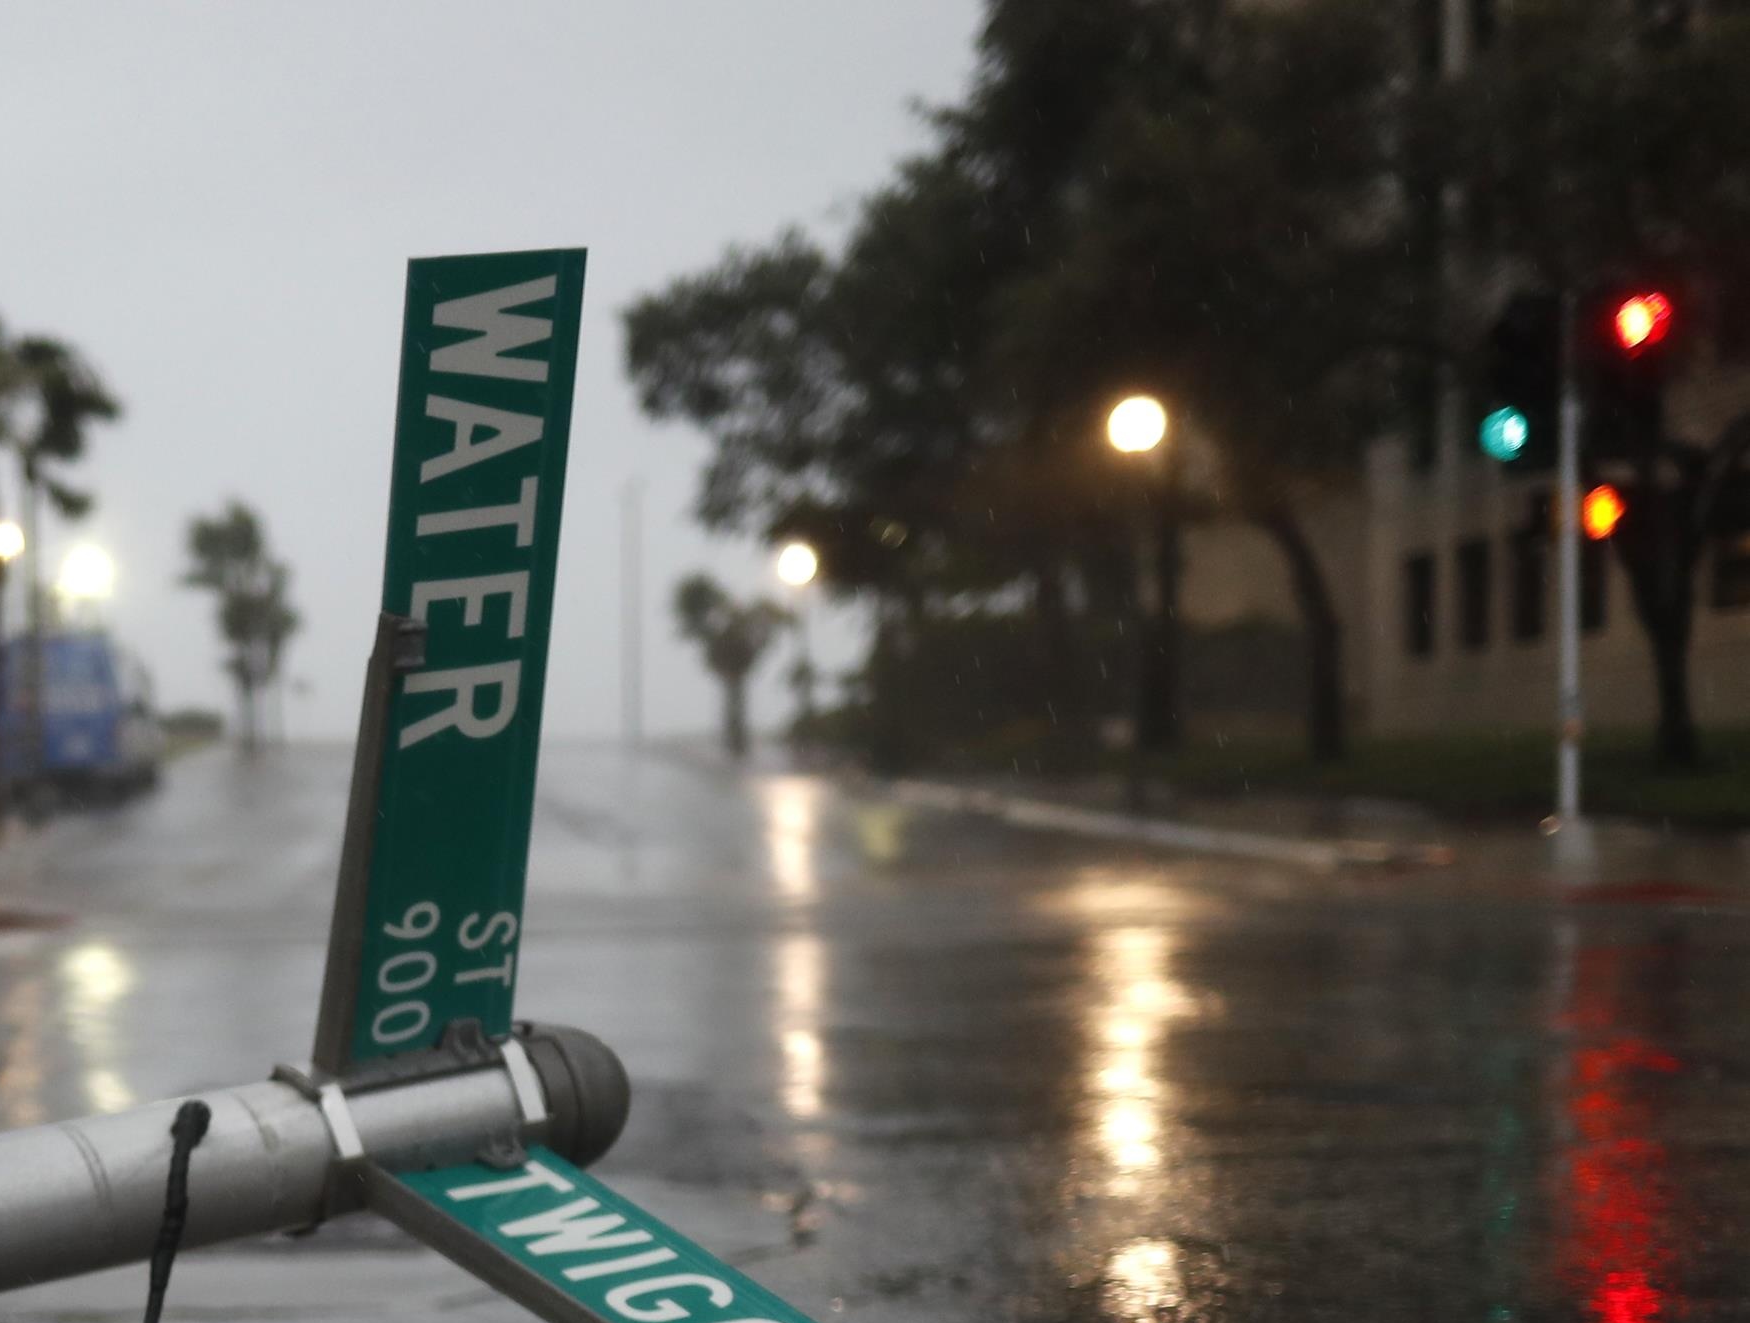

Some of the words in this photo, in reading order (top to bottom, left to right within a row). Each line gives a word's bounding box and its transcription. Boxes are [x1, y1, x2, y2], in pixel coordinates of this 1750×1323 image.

[399, 274, 558, 750] WATER
[371, 901, 441, 1044] 900
[454, 911, 518, 987] ST
